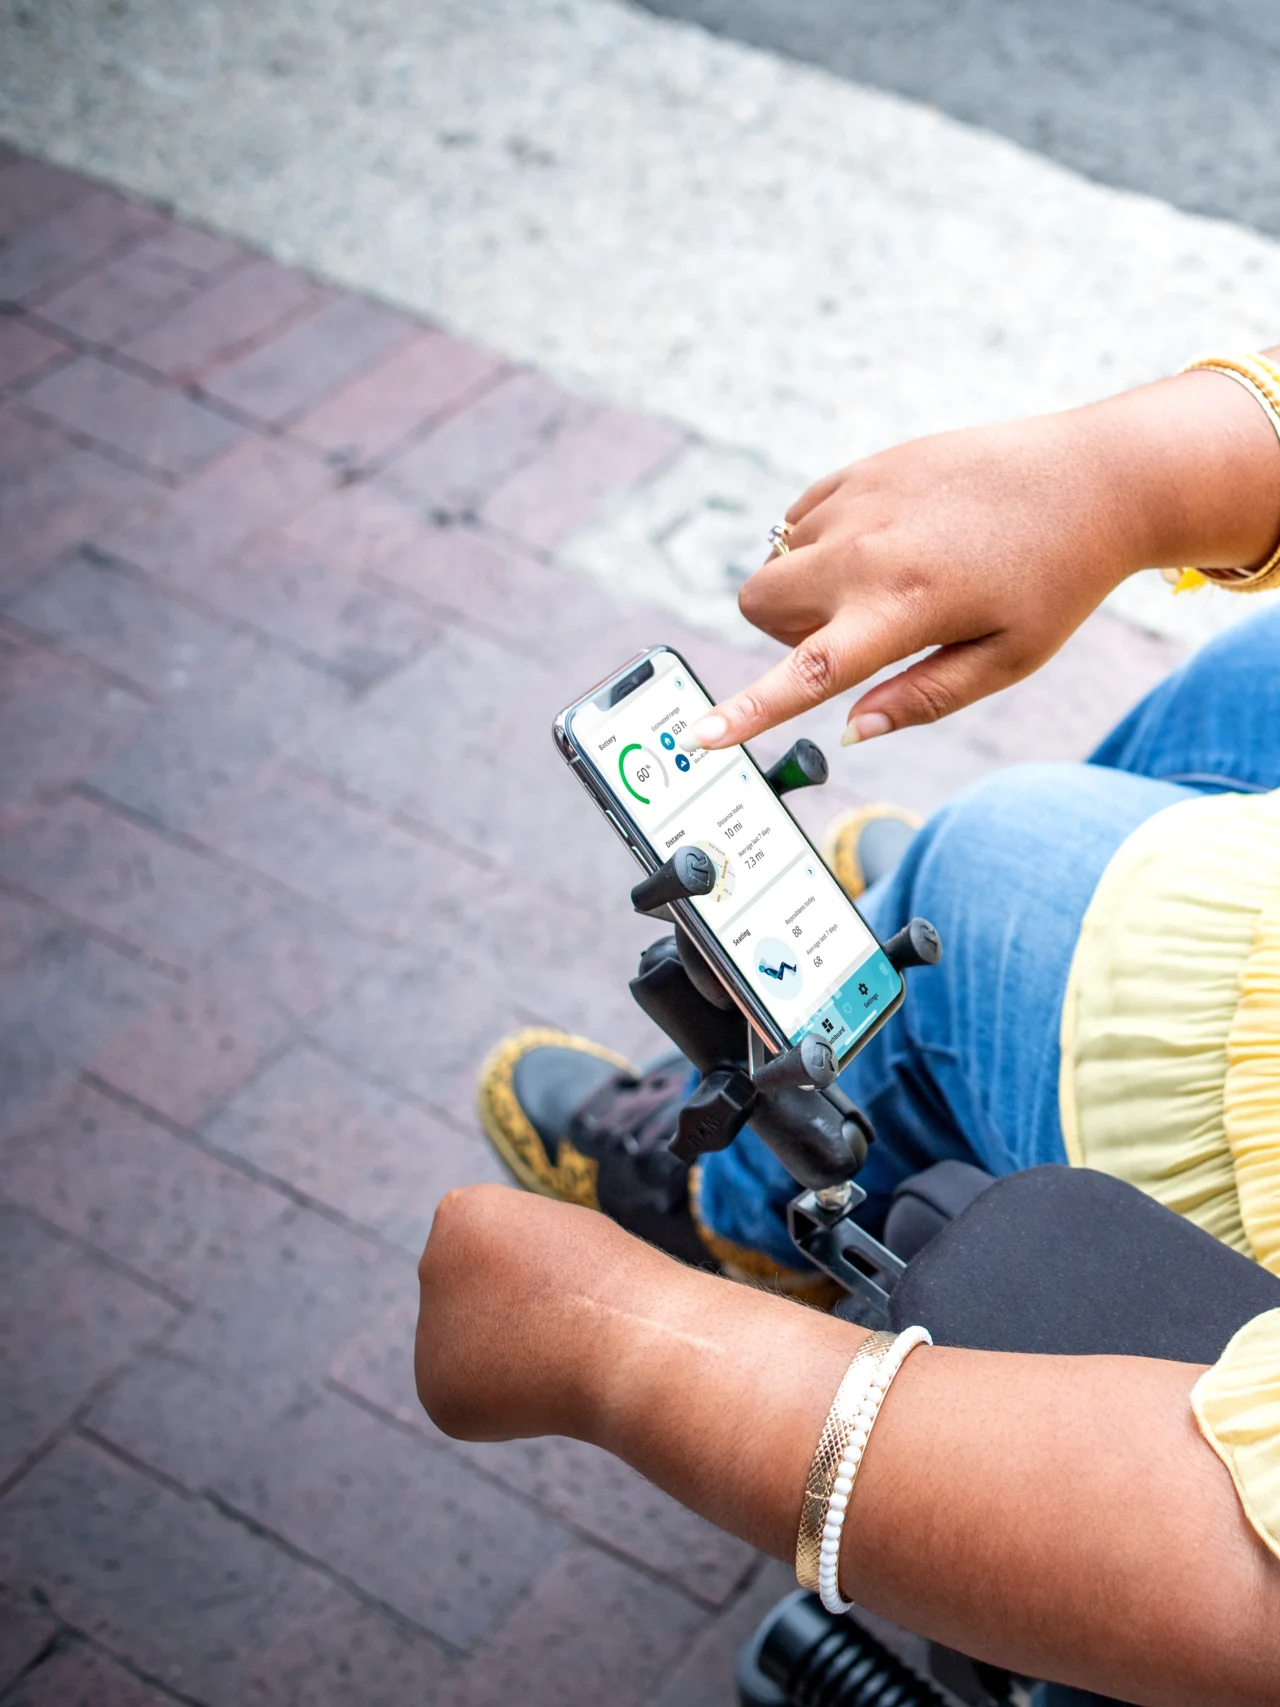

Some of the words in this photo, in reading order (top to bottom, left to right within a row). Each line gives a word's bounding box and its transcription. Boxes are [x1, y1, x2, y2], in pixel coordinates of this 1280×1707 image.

[650, 713, 670, 732] Estimated
[669, 707, 681, 719] range
[672, 722, 681, 735] 63
[598, 734, 617, 751] Battery
[717, 810, 733, 827] Distance
[732, 803, 744, 814] today
[665, 829, 685, 848] Distance
[724, 828, 735, 839] 10
[733, 820, 743, 832] mi
[738, 842, 753, 857] Average
[761, 827, 771, 837] days
[744, 857, 757, 869] 7,3
[755, 849, 765, 861] mi
[785, 905, 806, 925] Repositions
[804, 895, 816, 907] today
[733, 929, 752, 946] Seating
[792, 926, 803, 937] 88
[806, 940, 821, 955] Average
[828, 924, 838, 934] days
[813, 956, 823, 968] 68
[863, 993, 879, 1008] Settings
